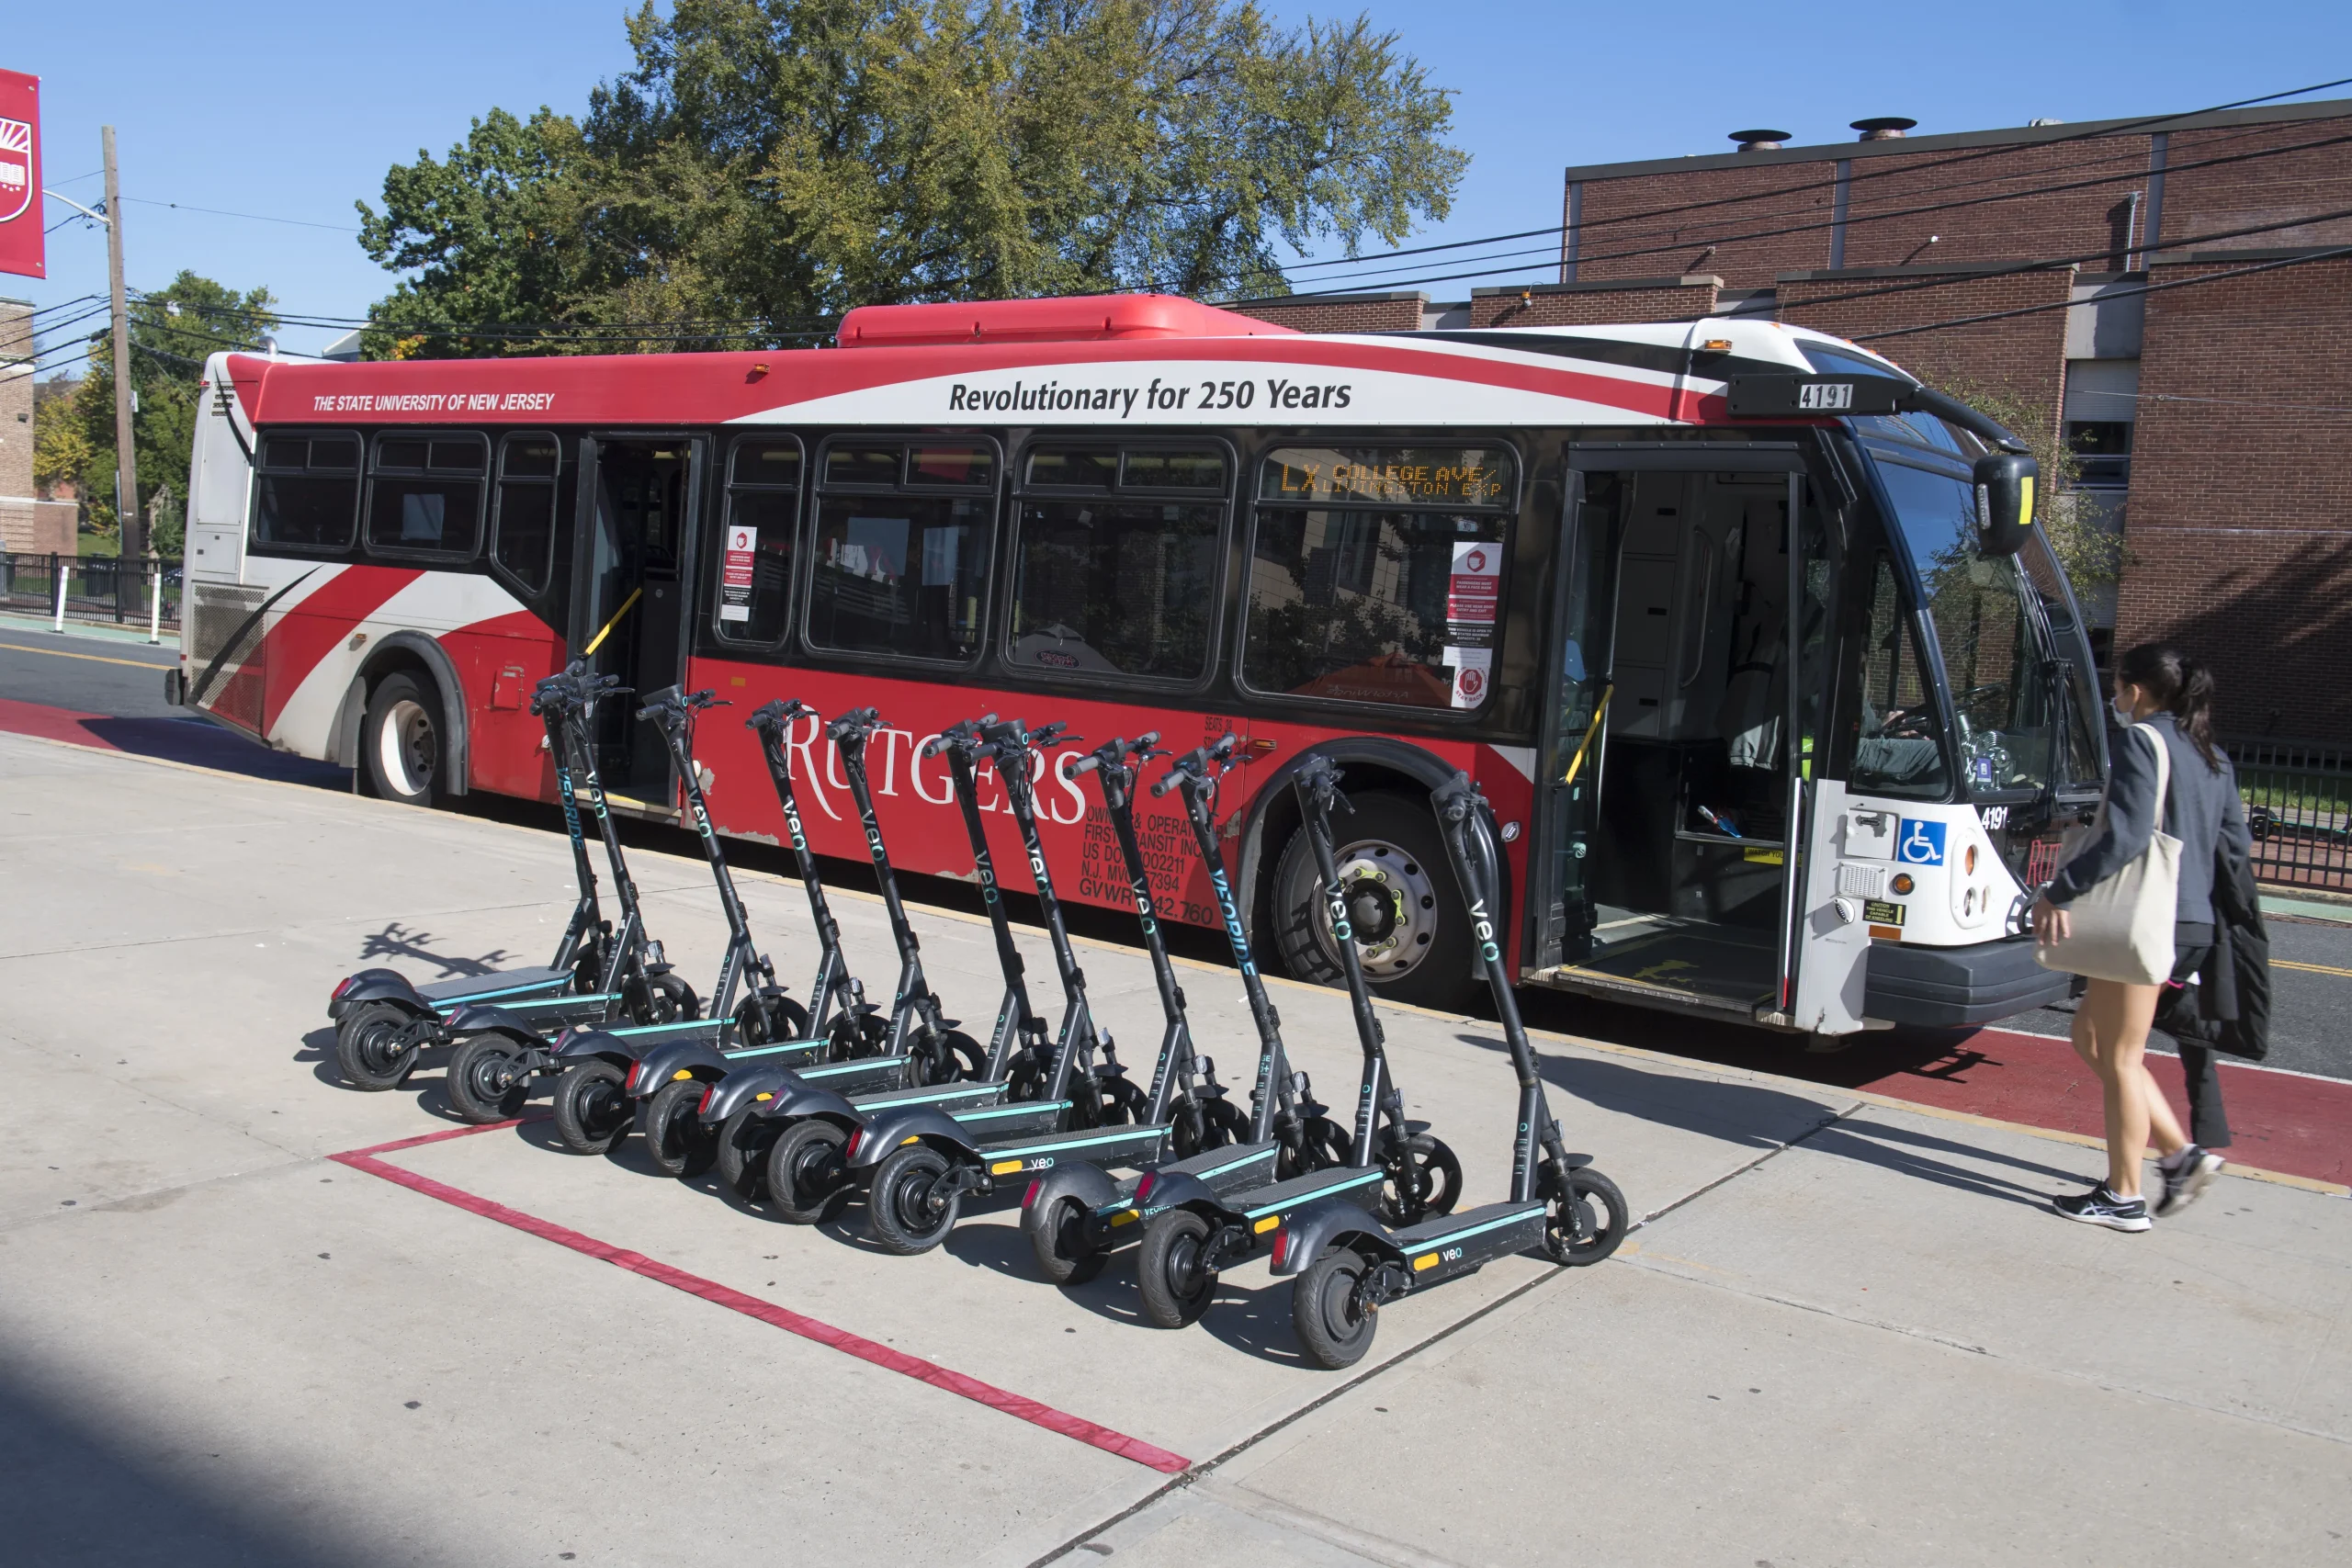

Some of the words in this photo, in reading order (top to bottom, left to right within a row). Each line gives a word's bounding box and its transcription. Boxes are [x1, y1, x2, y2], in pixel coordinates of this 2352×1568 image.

[313, 396, 335, 411] THE
[336, 395, 373, 411] STATE
[375, 394, 447, 411] UNIVERSITY
[447, 394, 466, 411] OF
[468, 394, 499, 411] NEW
[500, 393, 555, 411] JERSEY
[948, 380, 1139, 419] Revolutionary
[1147, 378, 1190, 410] for
[1197, 380, 1237, 410] 250
[1267, 378, 1351, 409] Years
[1802, 385, 1849, 408] 4191
[1282, 464, 1320, 491] LX
[1332, 465, 1428, 481] COLLEGE
[1323, 479, 1449, 496] LIVINGSTON
[1462, 483, 1501, 497] EXP
[557, 766, 585, 851] VEORIDE
[586, 770, 607, 819] veo
[688, 787, 712, 839] veo
[783, 799, 806, 852] veo
[861, 809, 886, 862] veo
[1134, 812, 1141, 829] &
[1982, 806, 2008, 830] 4191
[1024, 835, 1049, 894] veo
[1081, 860, 1102, 879] N.J.
[1083, 842, 1099, 860] US
[975, 849, 999, 904] veo
[1079, 878, 1133, 907] GVWR
[1130, 876, 1156, 935] veo
[1210, 868, 1256, 976] VEORIDE
[1325, 879, 1351, 941] veo
[1469, 897, 1499, 962] veo
[1030, 1156, 1055, 1169] veo
[1442, 1247, 1463, 1262] veo
